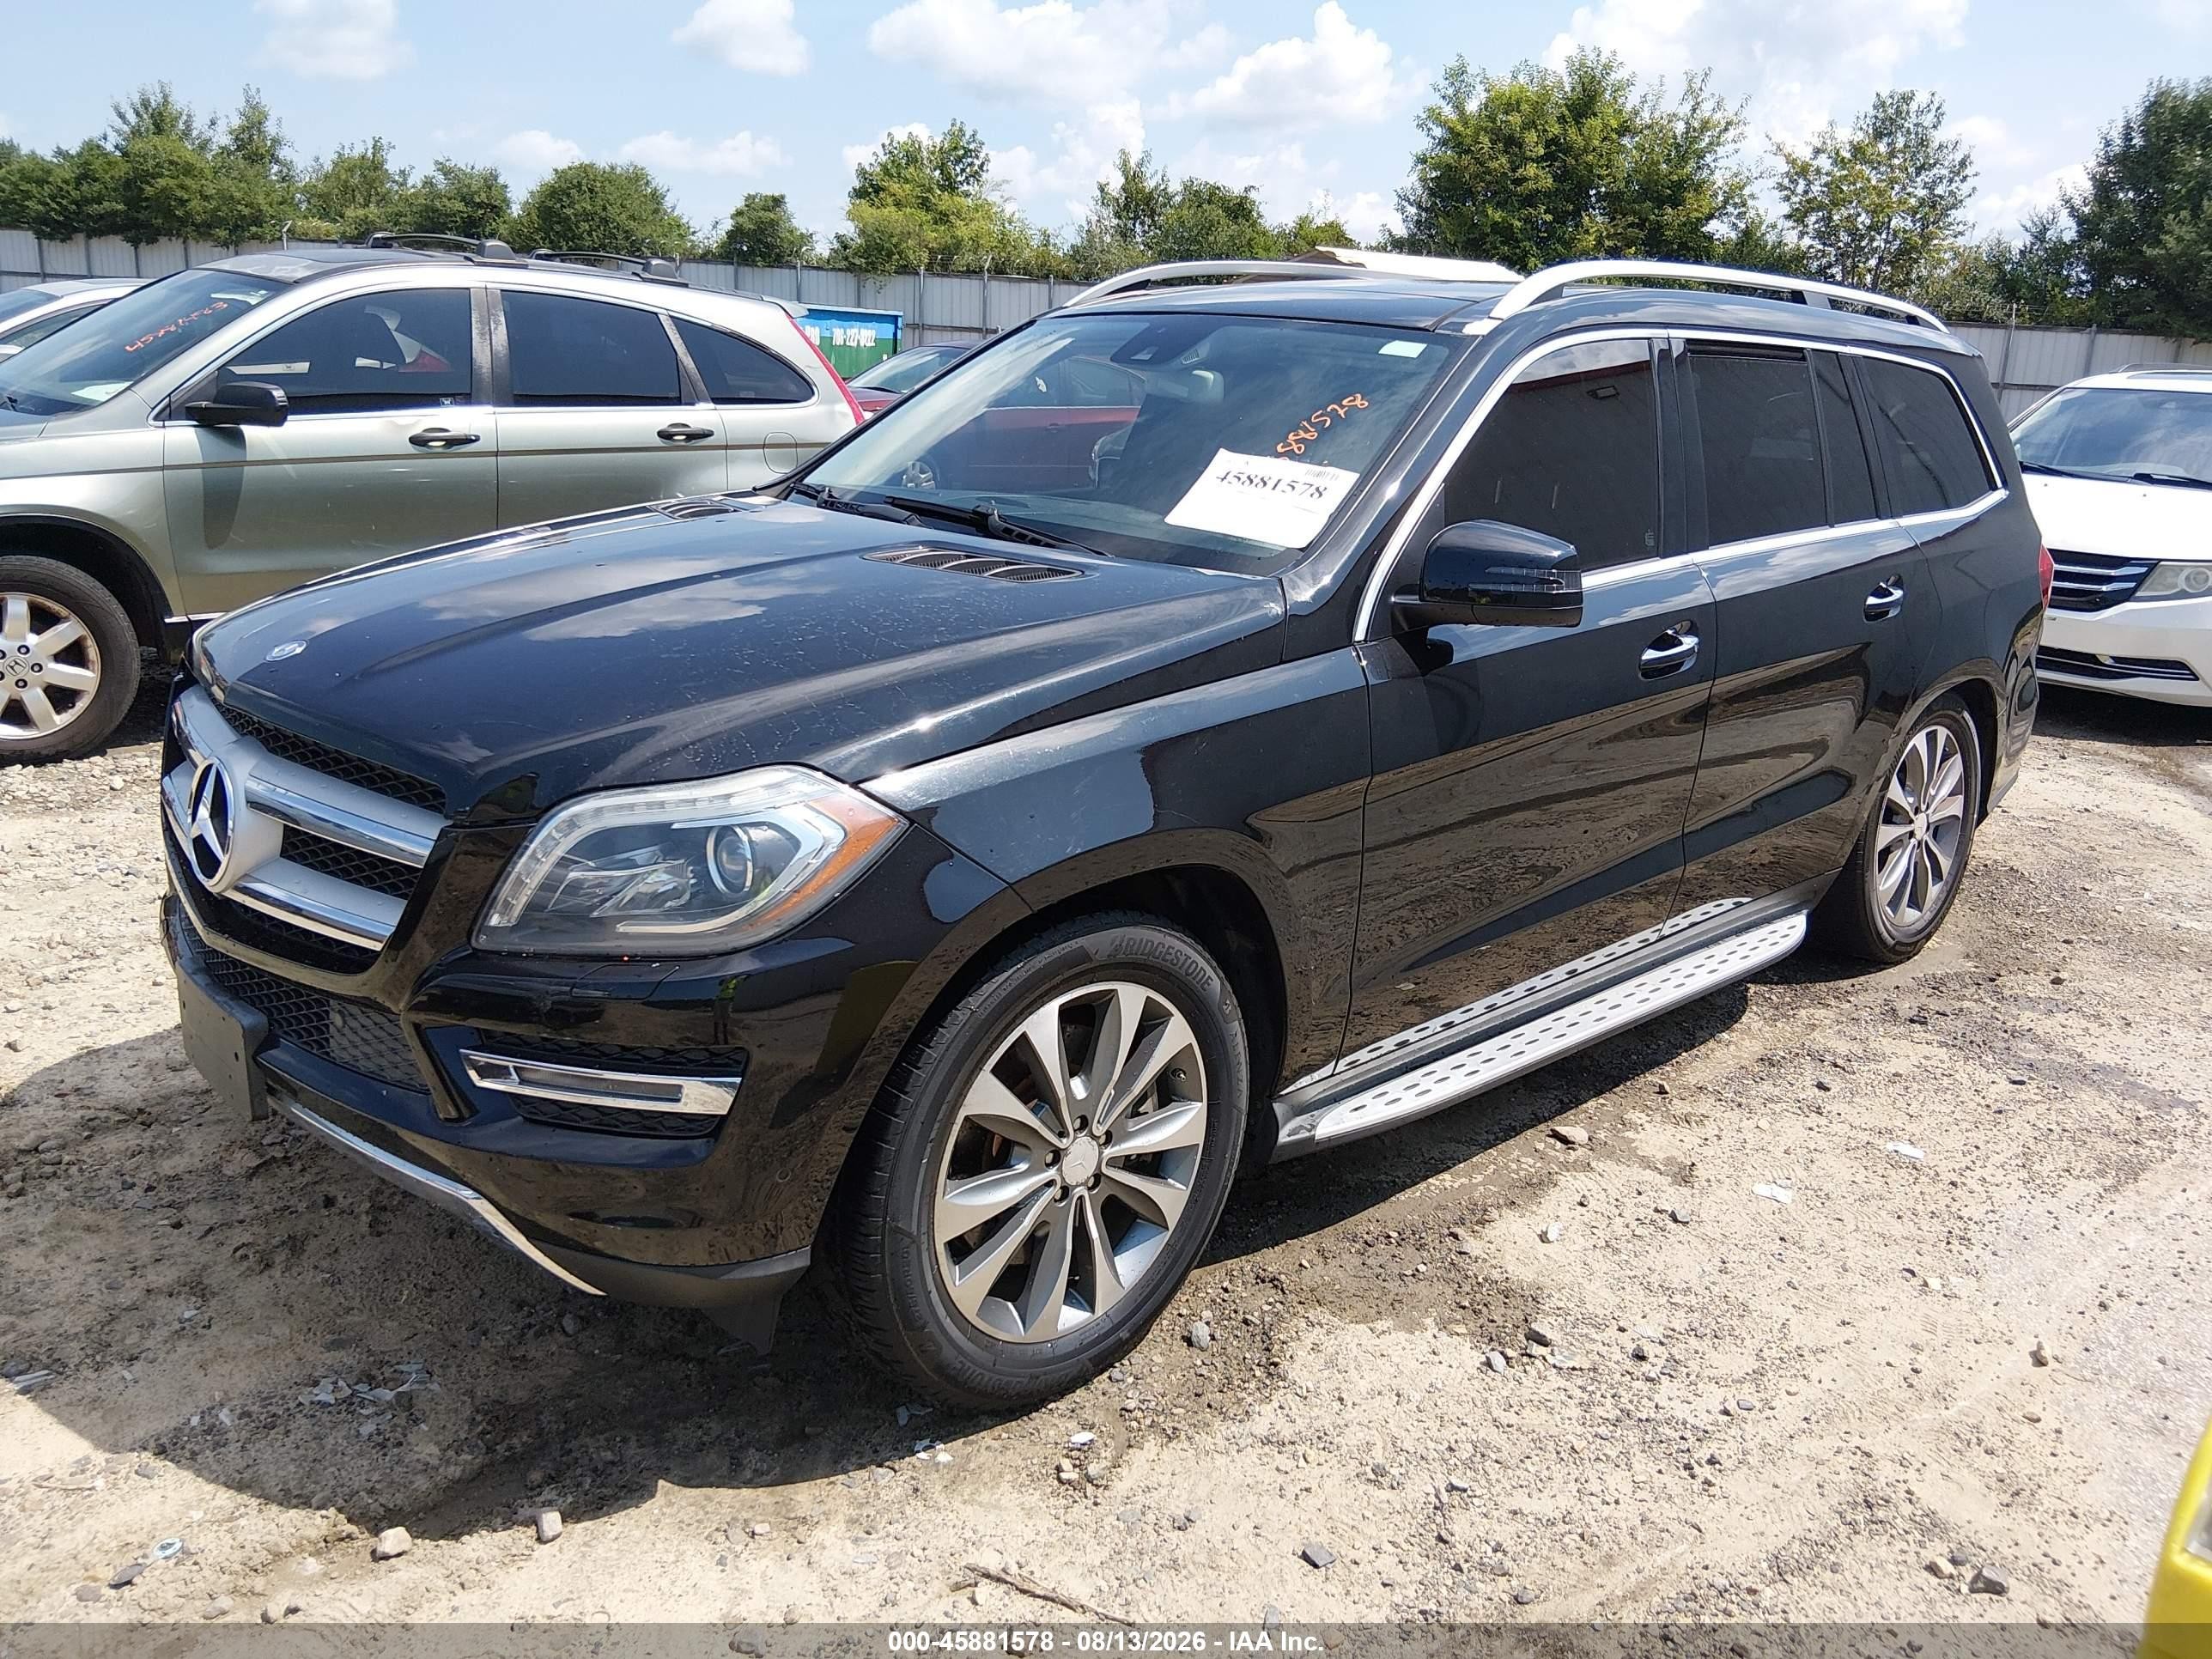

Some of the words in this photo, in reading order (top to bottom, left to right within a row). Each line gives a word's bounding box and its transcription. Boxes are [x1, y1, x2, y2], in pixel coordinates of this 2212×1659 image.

[1276, 393, 1370, 460] 881578
[1216, 470, 1328, 500] 45881578
[1107, 935, 1213, 992] BRIDGESTONE
